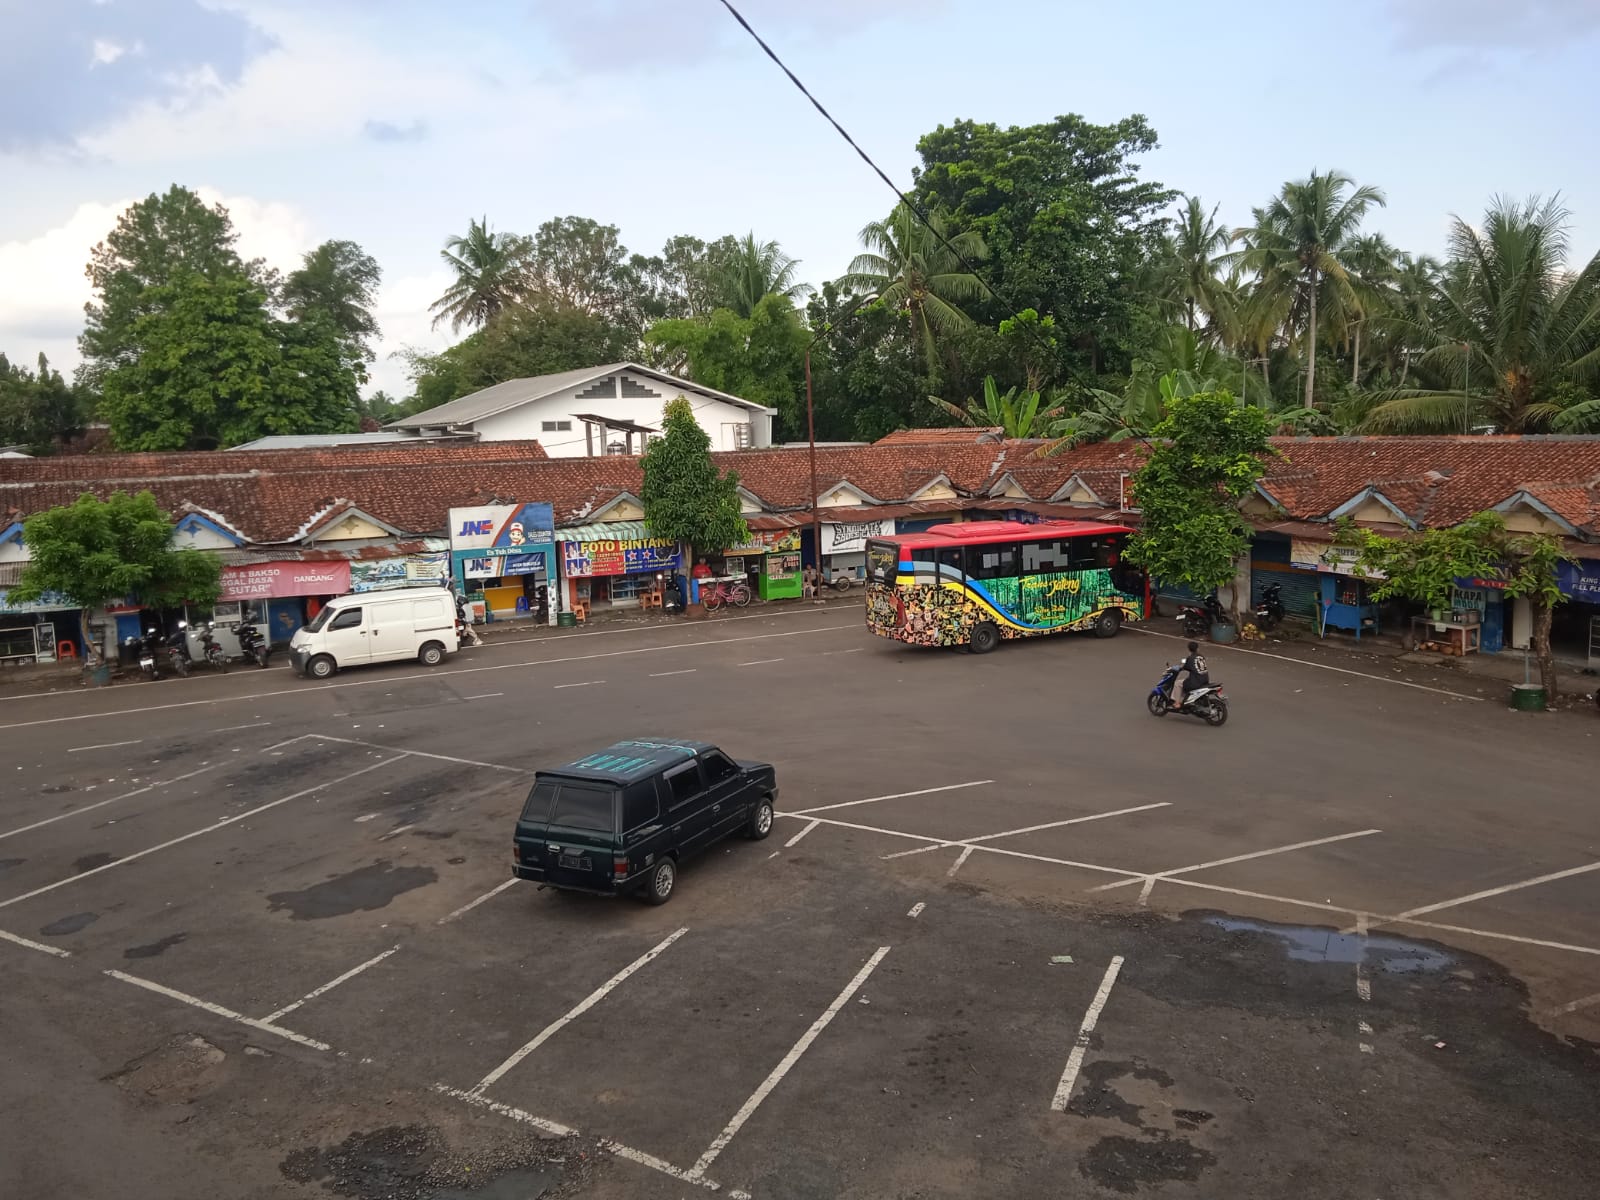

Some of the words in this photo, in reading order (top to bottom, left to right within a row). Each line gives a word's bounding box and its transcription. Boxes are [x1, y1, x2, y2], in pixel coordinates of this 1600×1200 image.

[457, 520, 493, 536] JNE
[580, 541, 615, 554] FOTO
[619, 537, 675, 551] BINTANG
[470, 558, 493, 572] JNE
[248, 576, 273, 585] RASA
[249, 569, 280, 578] BAKSO
